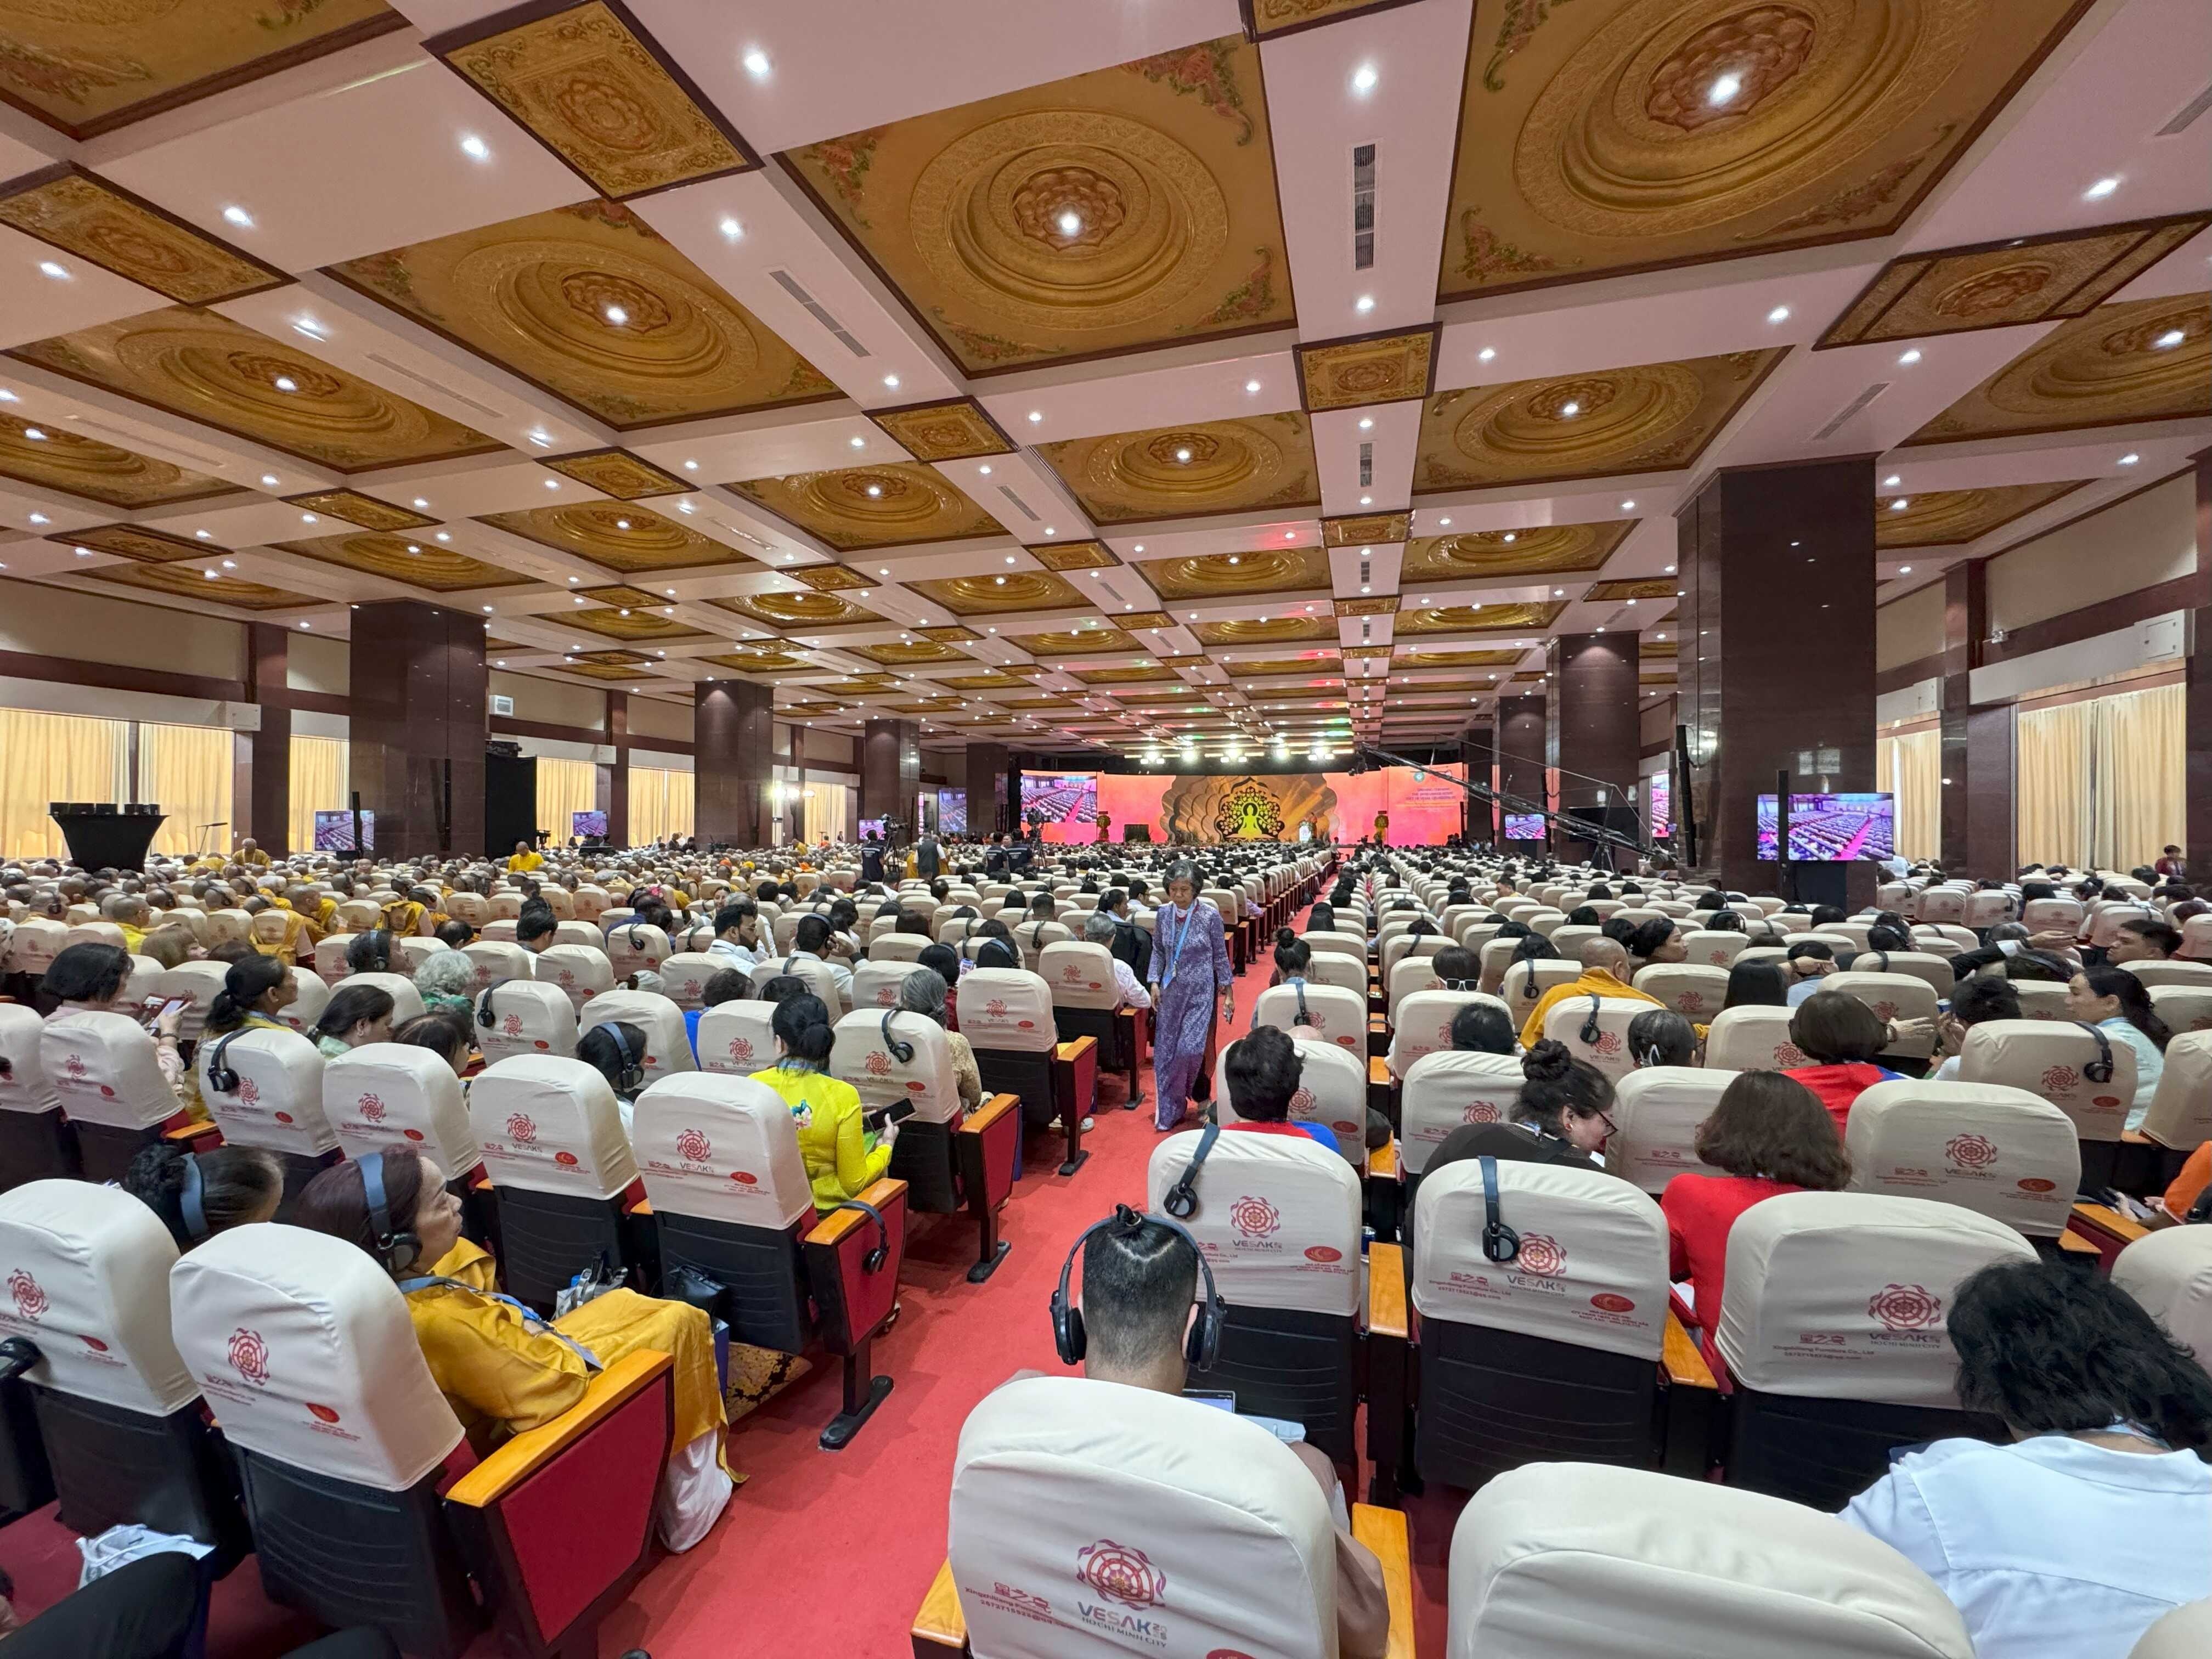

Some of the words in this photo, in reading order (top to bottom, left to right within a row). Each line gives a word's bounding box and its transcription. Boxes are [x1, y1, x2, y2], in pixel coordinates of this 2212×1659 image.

[1232, 1240, 1273, 1248] VESAK
[1506, 1274, 1555, 1290] VESAK
[1870, 1333, 1927, 1342] VESAK
[1077, 1601, 1151, 1635] VESAK
[1082, 1617, 1097, 1626] HO
[1098, 1621, 1115, 1632] CHI
[1117, 1628, 1143, 1641] MINH
[1145, 1637, 1167, 1648] CITY
